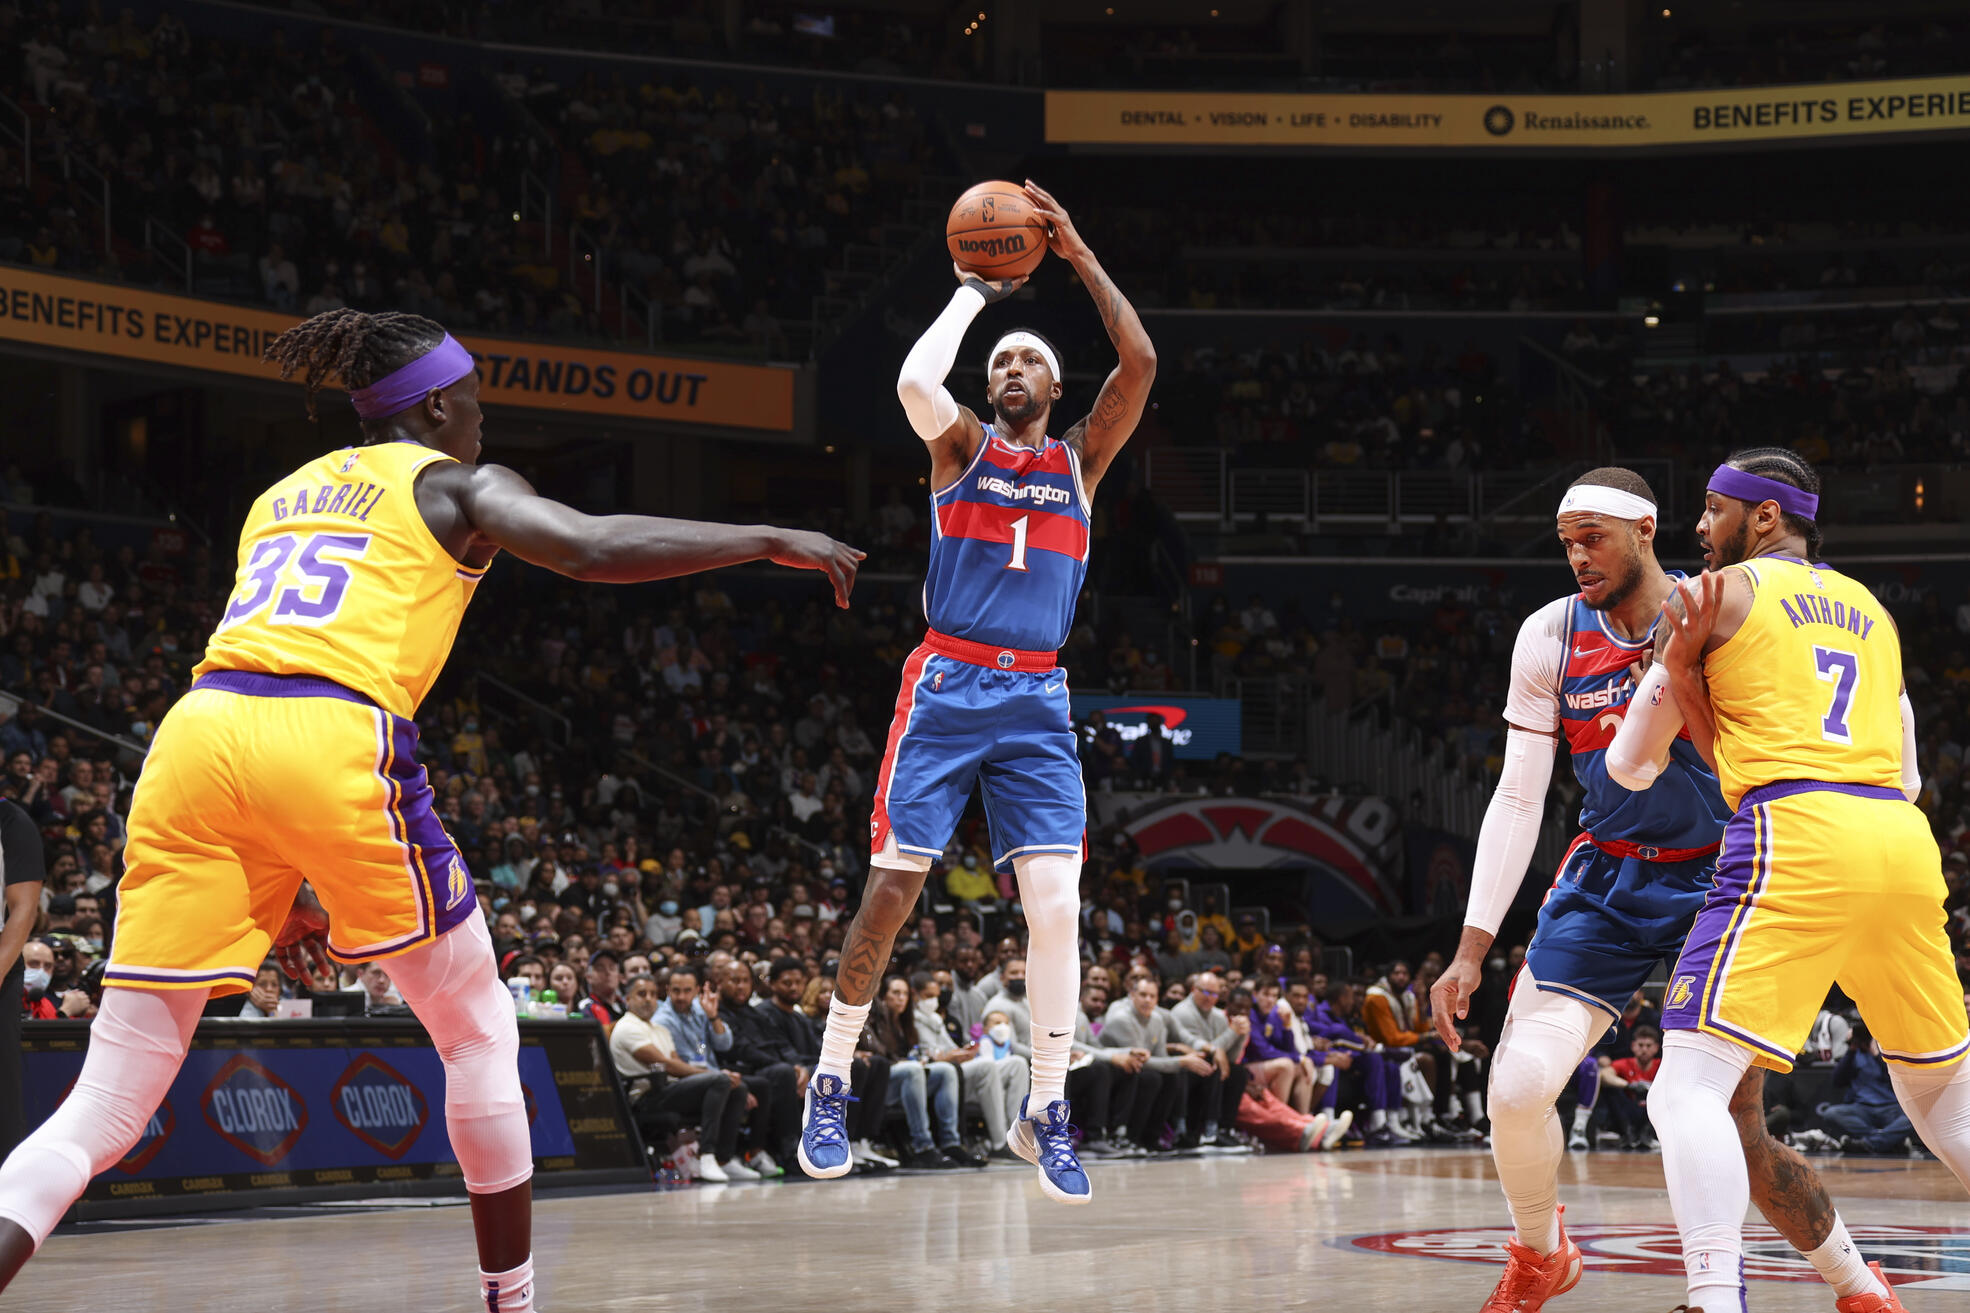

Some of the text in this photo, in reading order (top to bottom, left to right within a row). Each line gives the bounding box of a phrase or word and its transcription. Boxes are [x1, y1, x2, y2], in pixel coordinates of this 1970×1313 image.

[1120, 111, 1443, 129] DENTAL VISION LIFE DISABILITY
[1693, 91, 1970, 131] BENEFITS EXPERIE
[958, 233, 1027, 257] Wilson
[626, 366, 708, 406] OUT
[272, 481, 386, 522] GABRIEL
[976, 476, 1071, 505] washington
[1004, 513, 1030, 572] 1
[218, 531, 373, 631] 35
[1780, 593, 1875, 641] ANTHONY
[1812, 644, 1860, 744] 7
[211, 1086, 299, 1134] CLOROX
[340, 1083, 421, 1129] CLOROX
